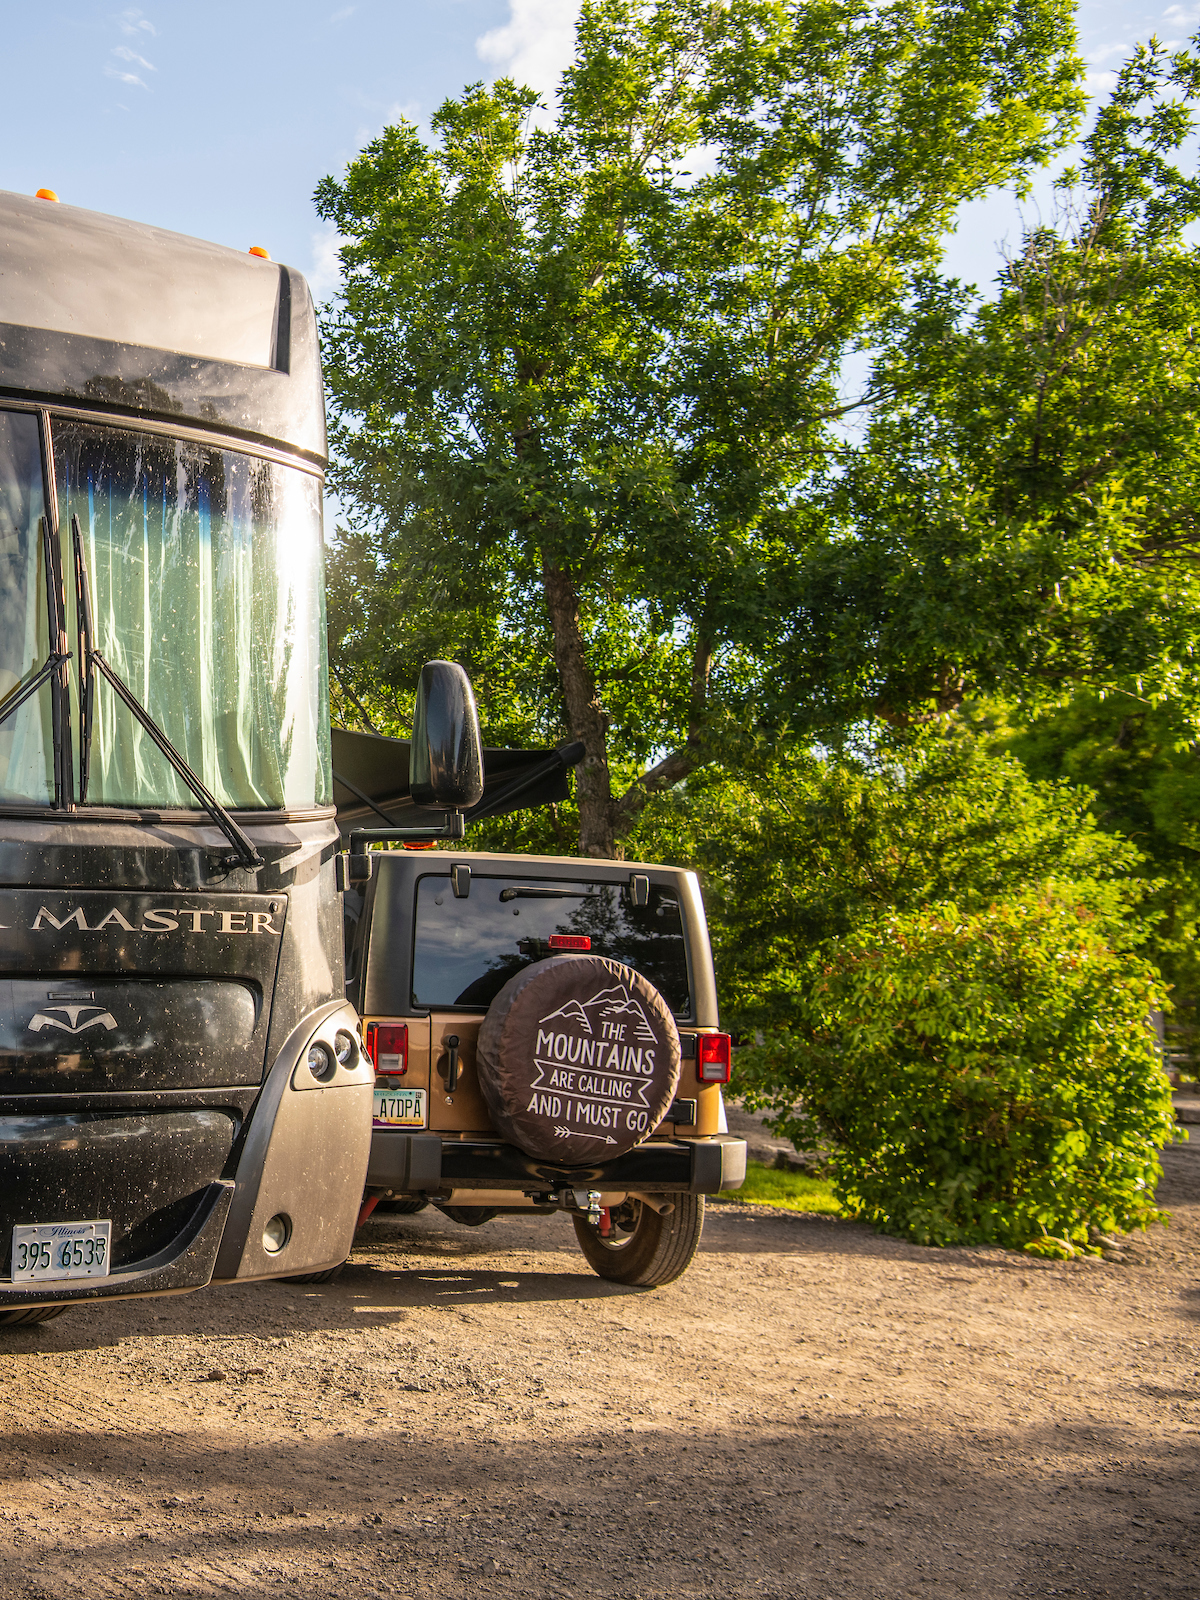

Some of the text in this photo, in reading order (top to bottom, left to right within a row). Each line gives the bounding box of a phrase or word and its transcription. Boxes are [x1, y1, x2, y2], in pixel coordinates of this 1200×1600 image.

[29, 905, 281, 935] MASTER
[601, 1021, 628, 1042] THE
[535, 1028, 656, 1075] MOUNTAINS
[549, 1069, 633, 1099] ARE CALLING
[373, 1098, 421, 1118] A7DPA
[526, 1092, 649, 1132] AND I MUST GO
[39, 1225, 88, 1238] Illinois
[17, 1240, 52, 1271] 395
